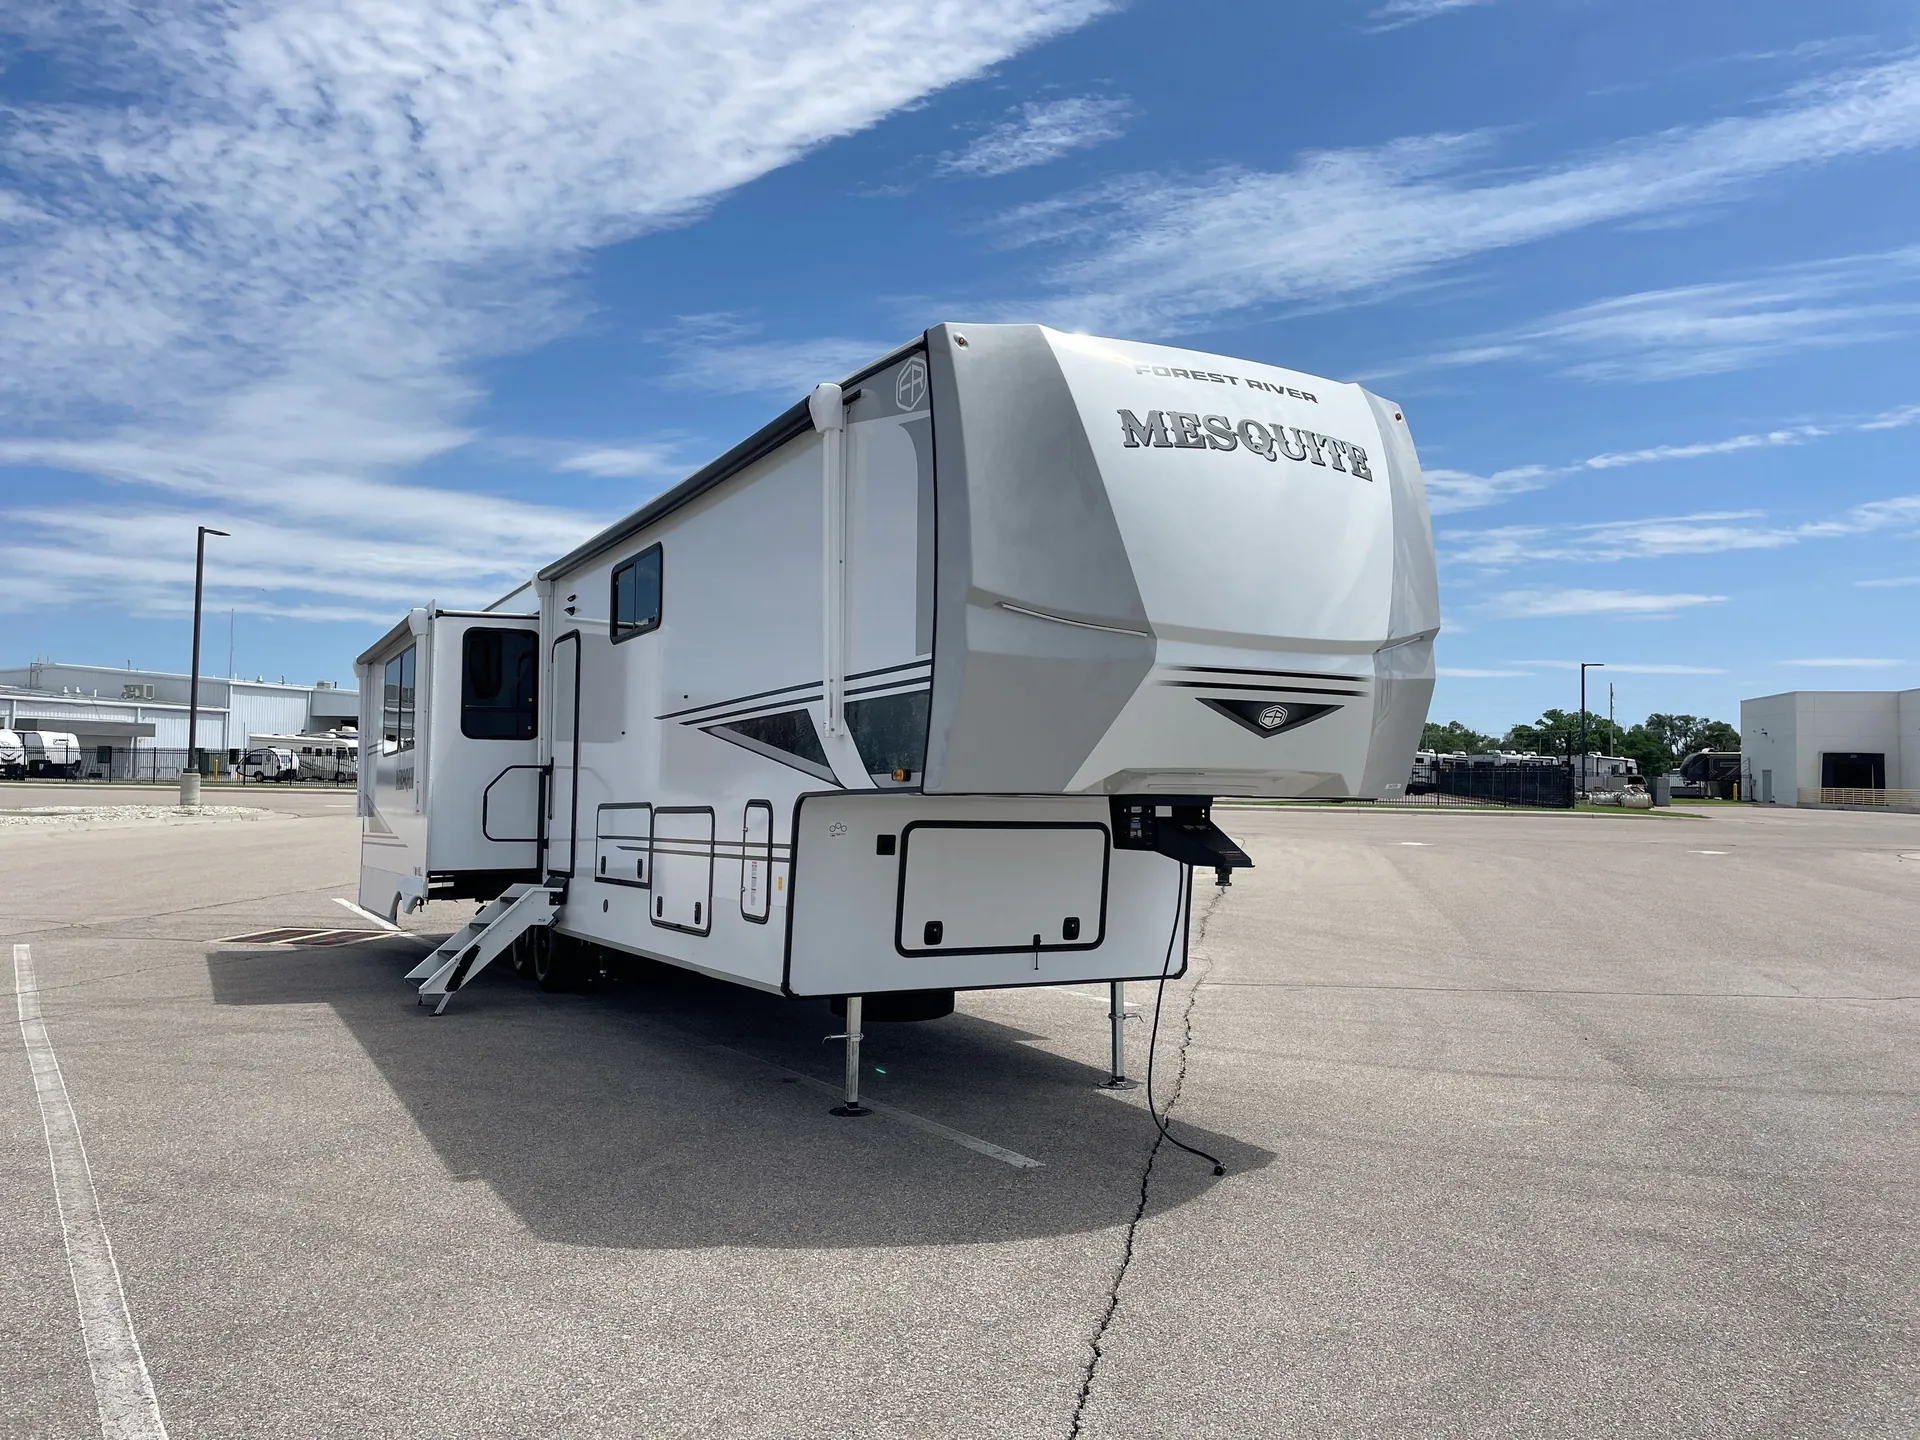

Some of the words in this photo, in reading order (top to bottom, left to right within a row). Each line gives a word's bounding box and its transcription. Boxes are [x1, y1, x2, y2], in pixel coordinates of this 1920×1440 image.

[1135, 365, 1239, 386] FOREST
[1244, 378, 1319, 404] RIVER
[1117, 408, 1373, 482] MESQUITE
